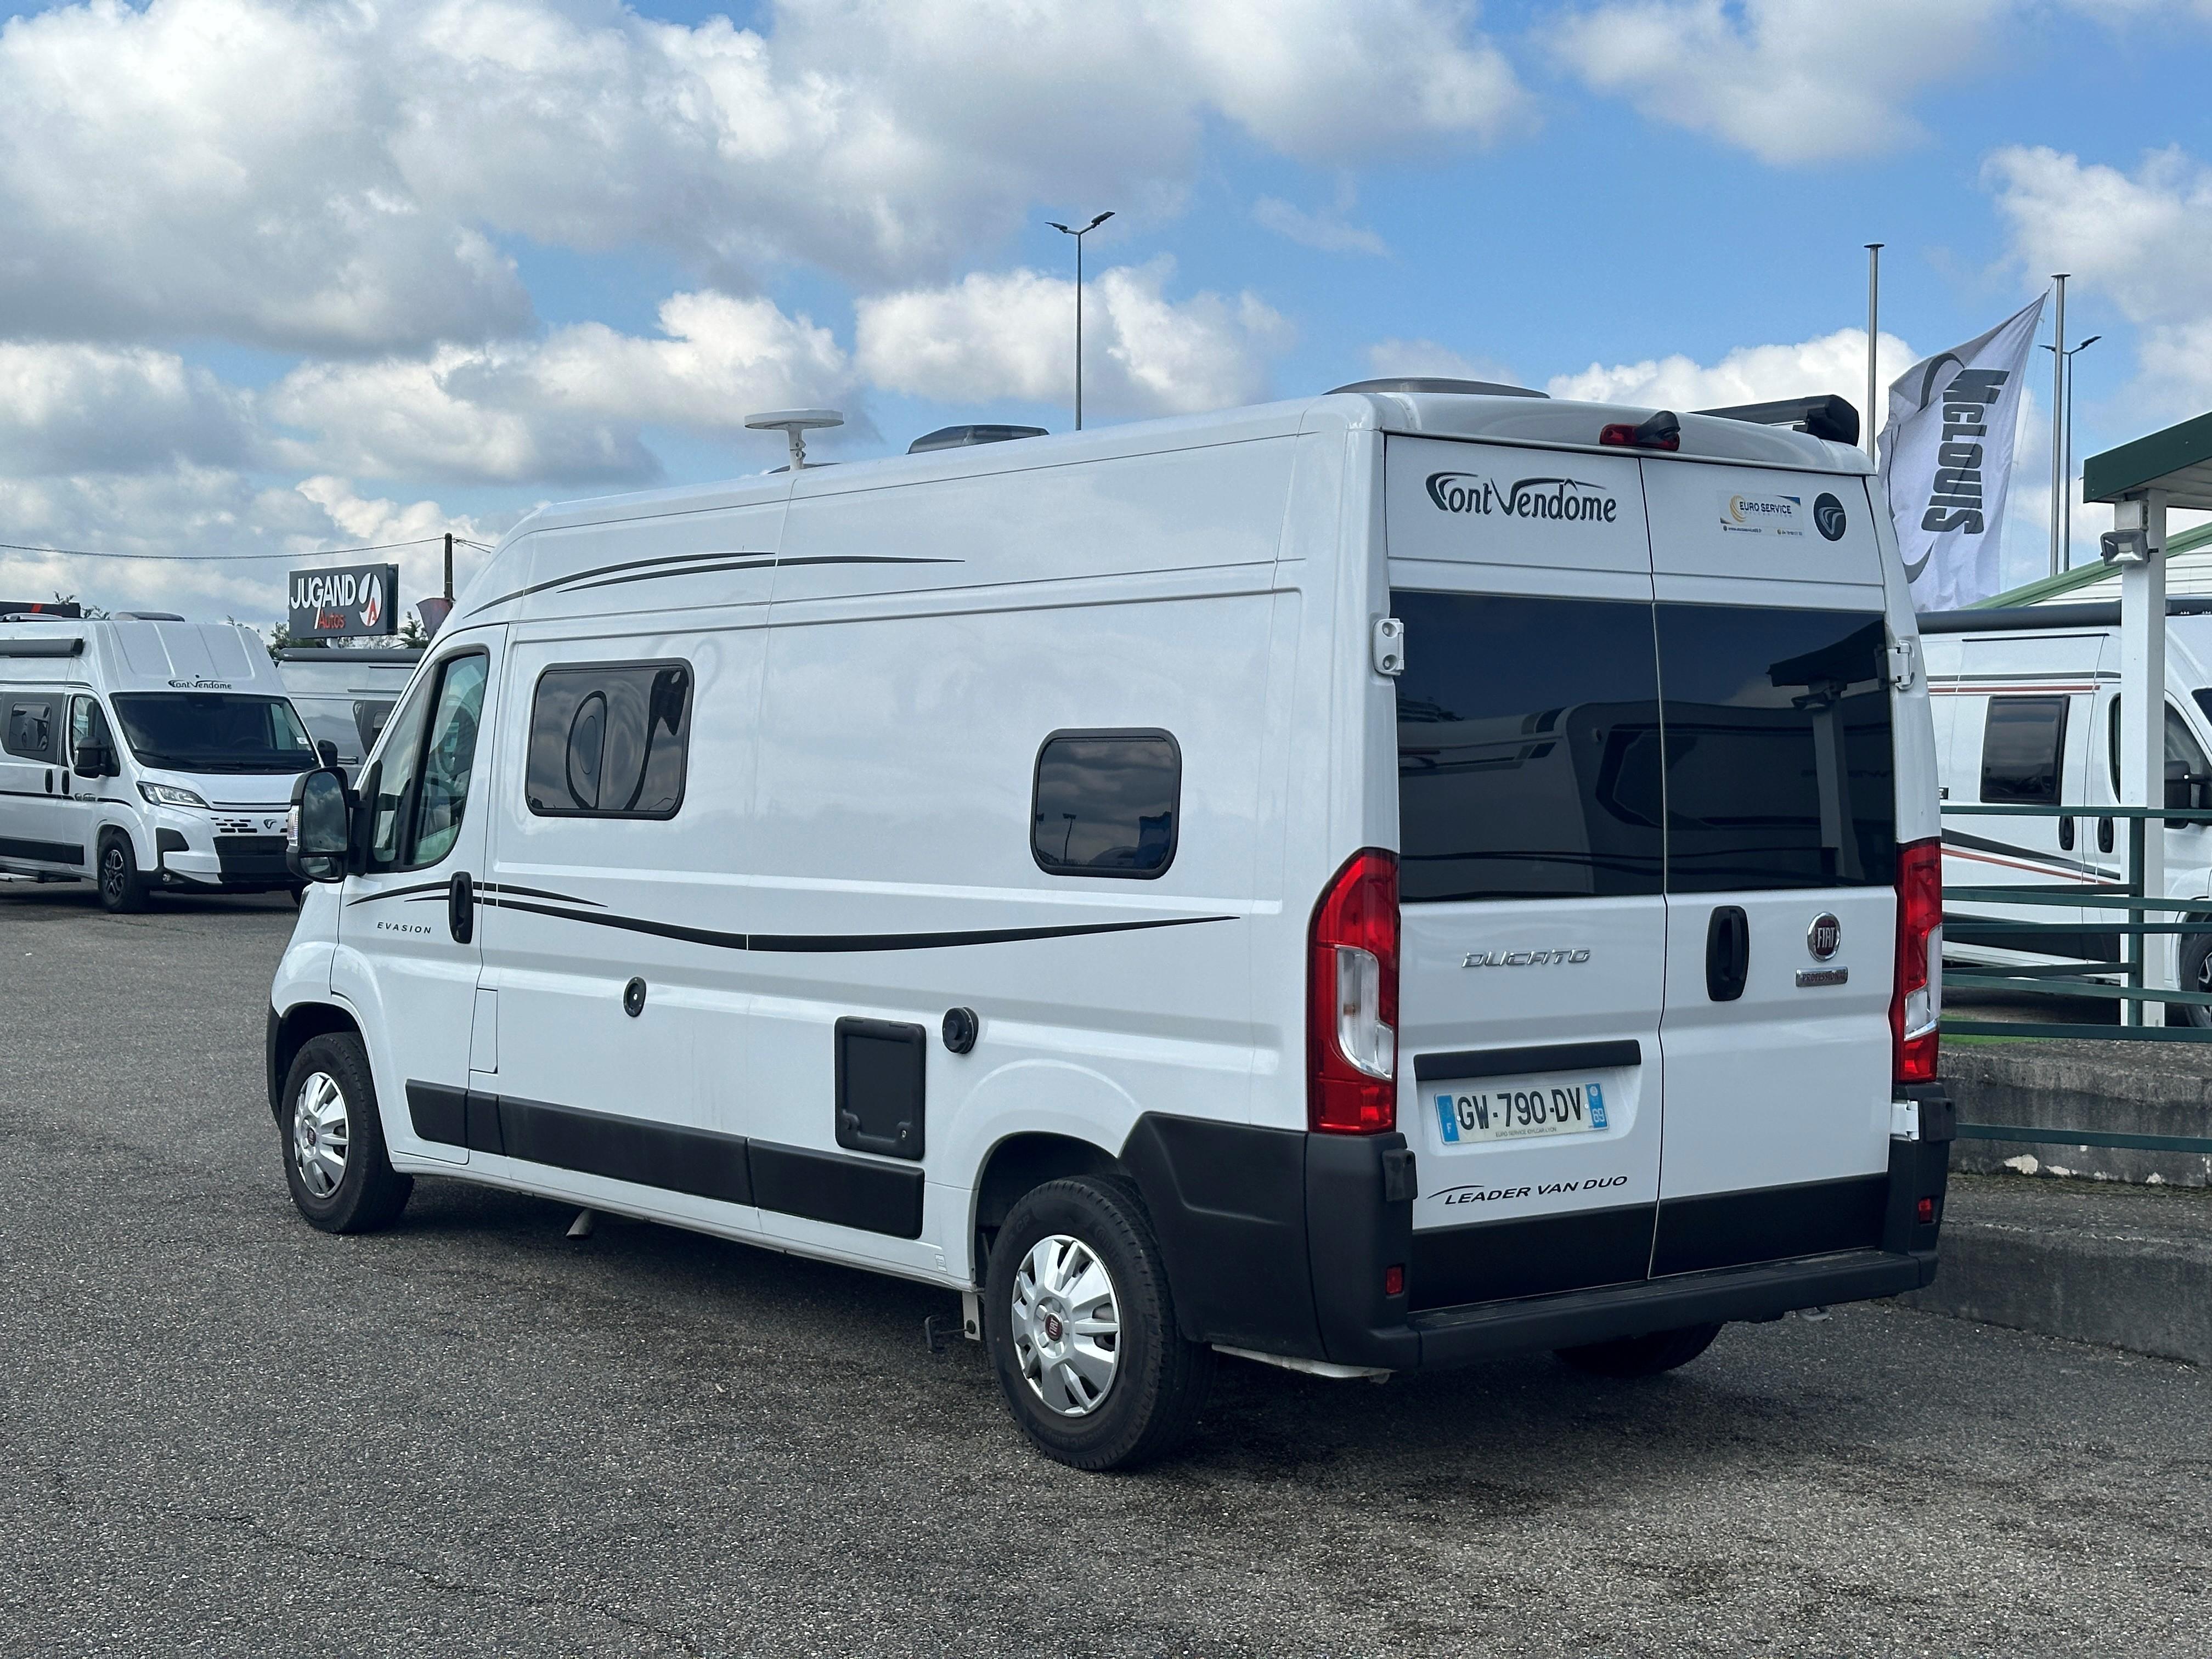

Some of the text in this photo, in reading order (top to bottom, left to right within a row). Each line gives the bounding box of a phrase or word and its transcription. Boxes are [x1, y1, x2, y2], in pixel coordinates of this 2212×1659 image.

[1739, 501, 1792, 514] EURO SERVICE
[291, 574, 356, 629] JUGAND
[318, 610, 346, 629] Autos
[377, 922, 431, 934] EVASION
[1817, 927, 1835, 948] FIAT
[1462, 948, 1590, 968] DUCATO
[1457, 1087, 1581, 1130] GW-790-DV
[1592, 1108, 1605, 1122] 69
[1446, 1122, 1452, 1133] F
[1444, 1176, 1628, 1205] LEADER VAN DUO
[1049, 1317, 1059, 1335] FIAT
